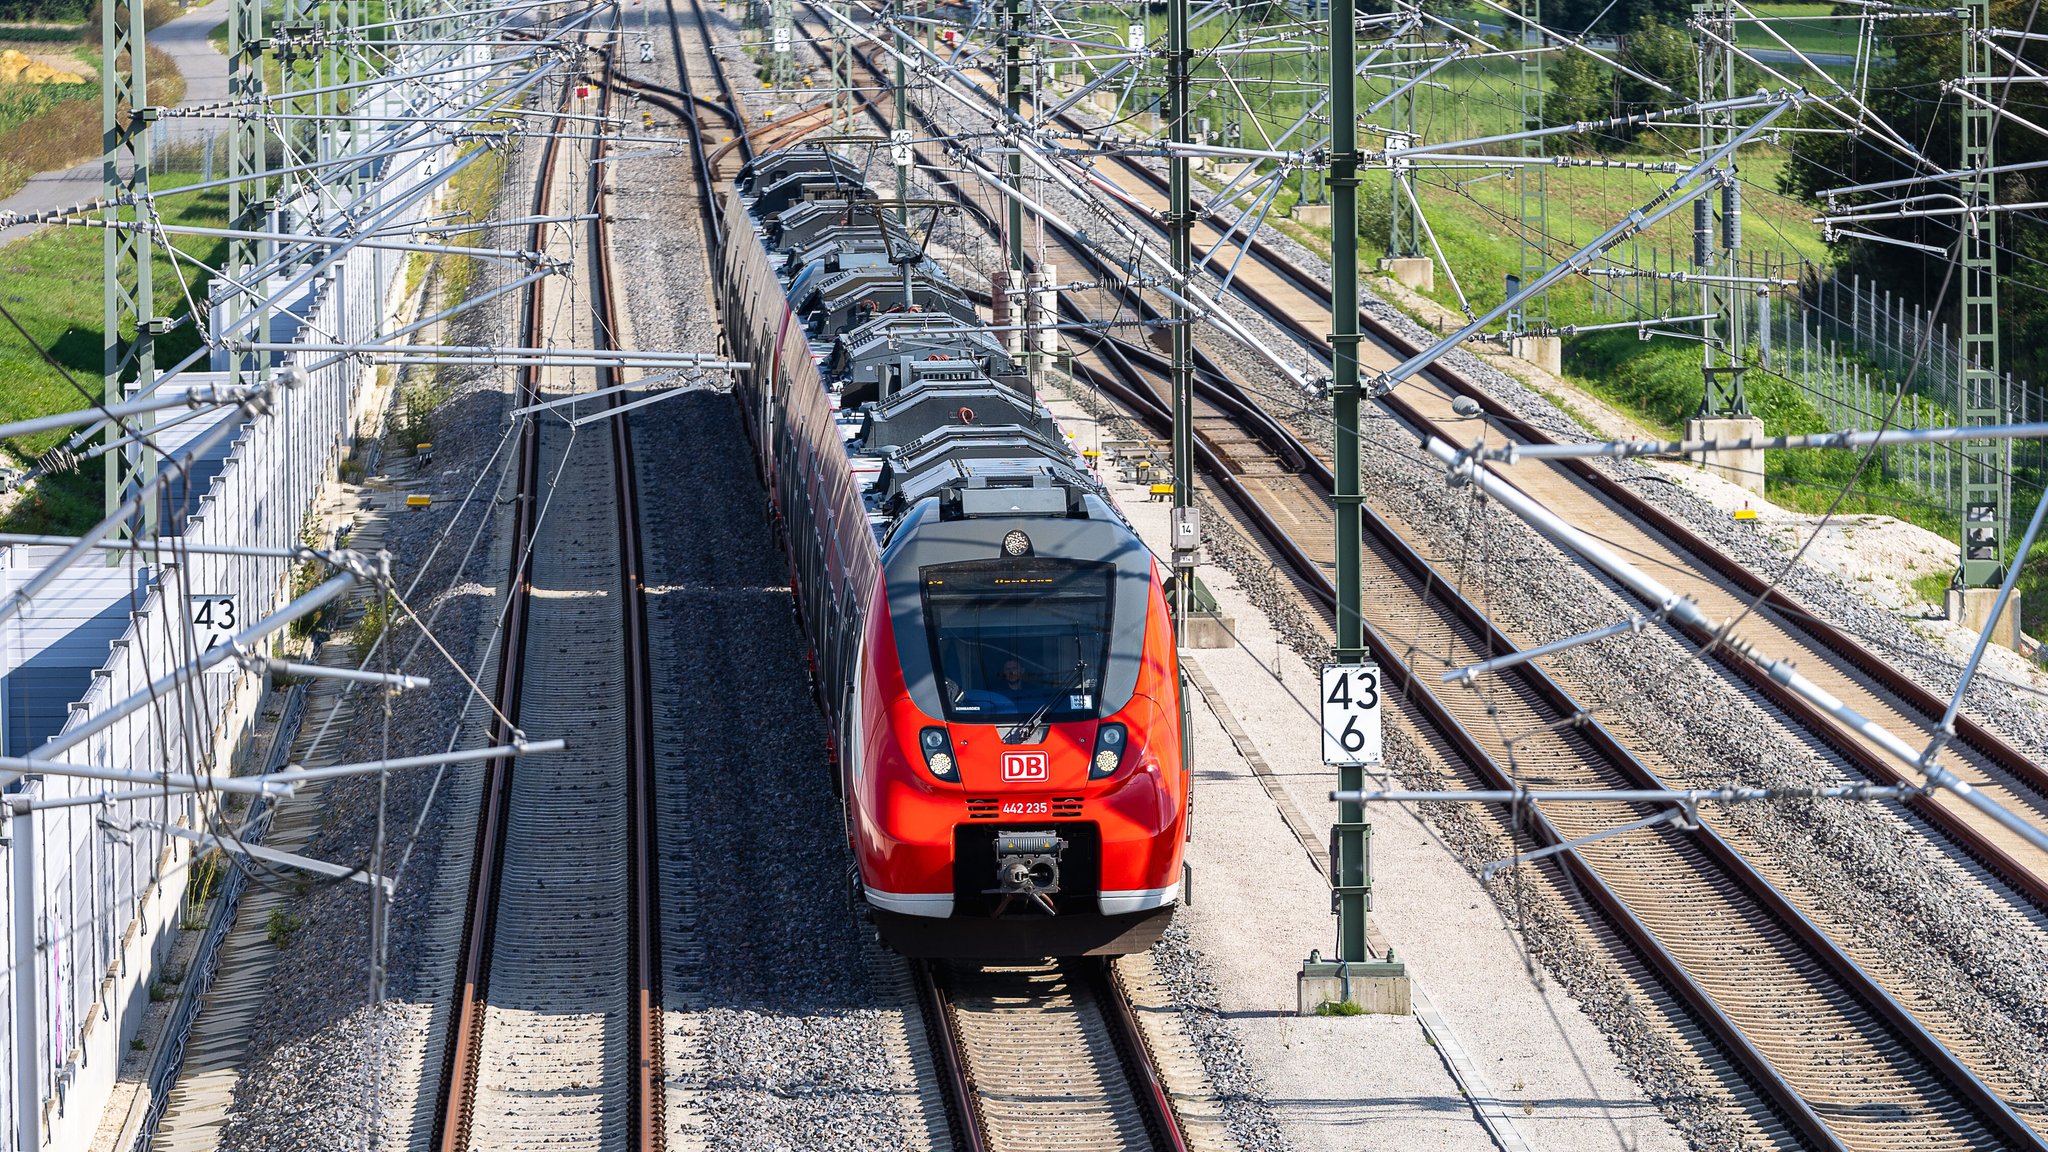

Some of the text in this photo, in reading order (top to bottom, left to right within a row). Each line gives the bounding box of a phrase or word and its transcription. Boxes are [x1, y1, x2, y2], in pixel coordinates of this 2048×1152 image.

[1182, 525, 1191, 534] 14
[193, 598, 236, 630] 43
[1326, 672, 1378, 710] 43
[1340, 714, 1365, 753] 6
[1007, 756, 1043, 777] DB
[1002, 802, 1048, 814] 442 235
